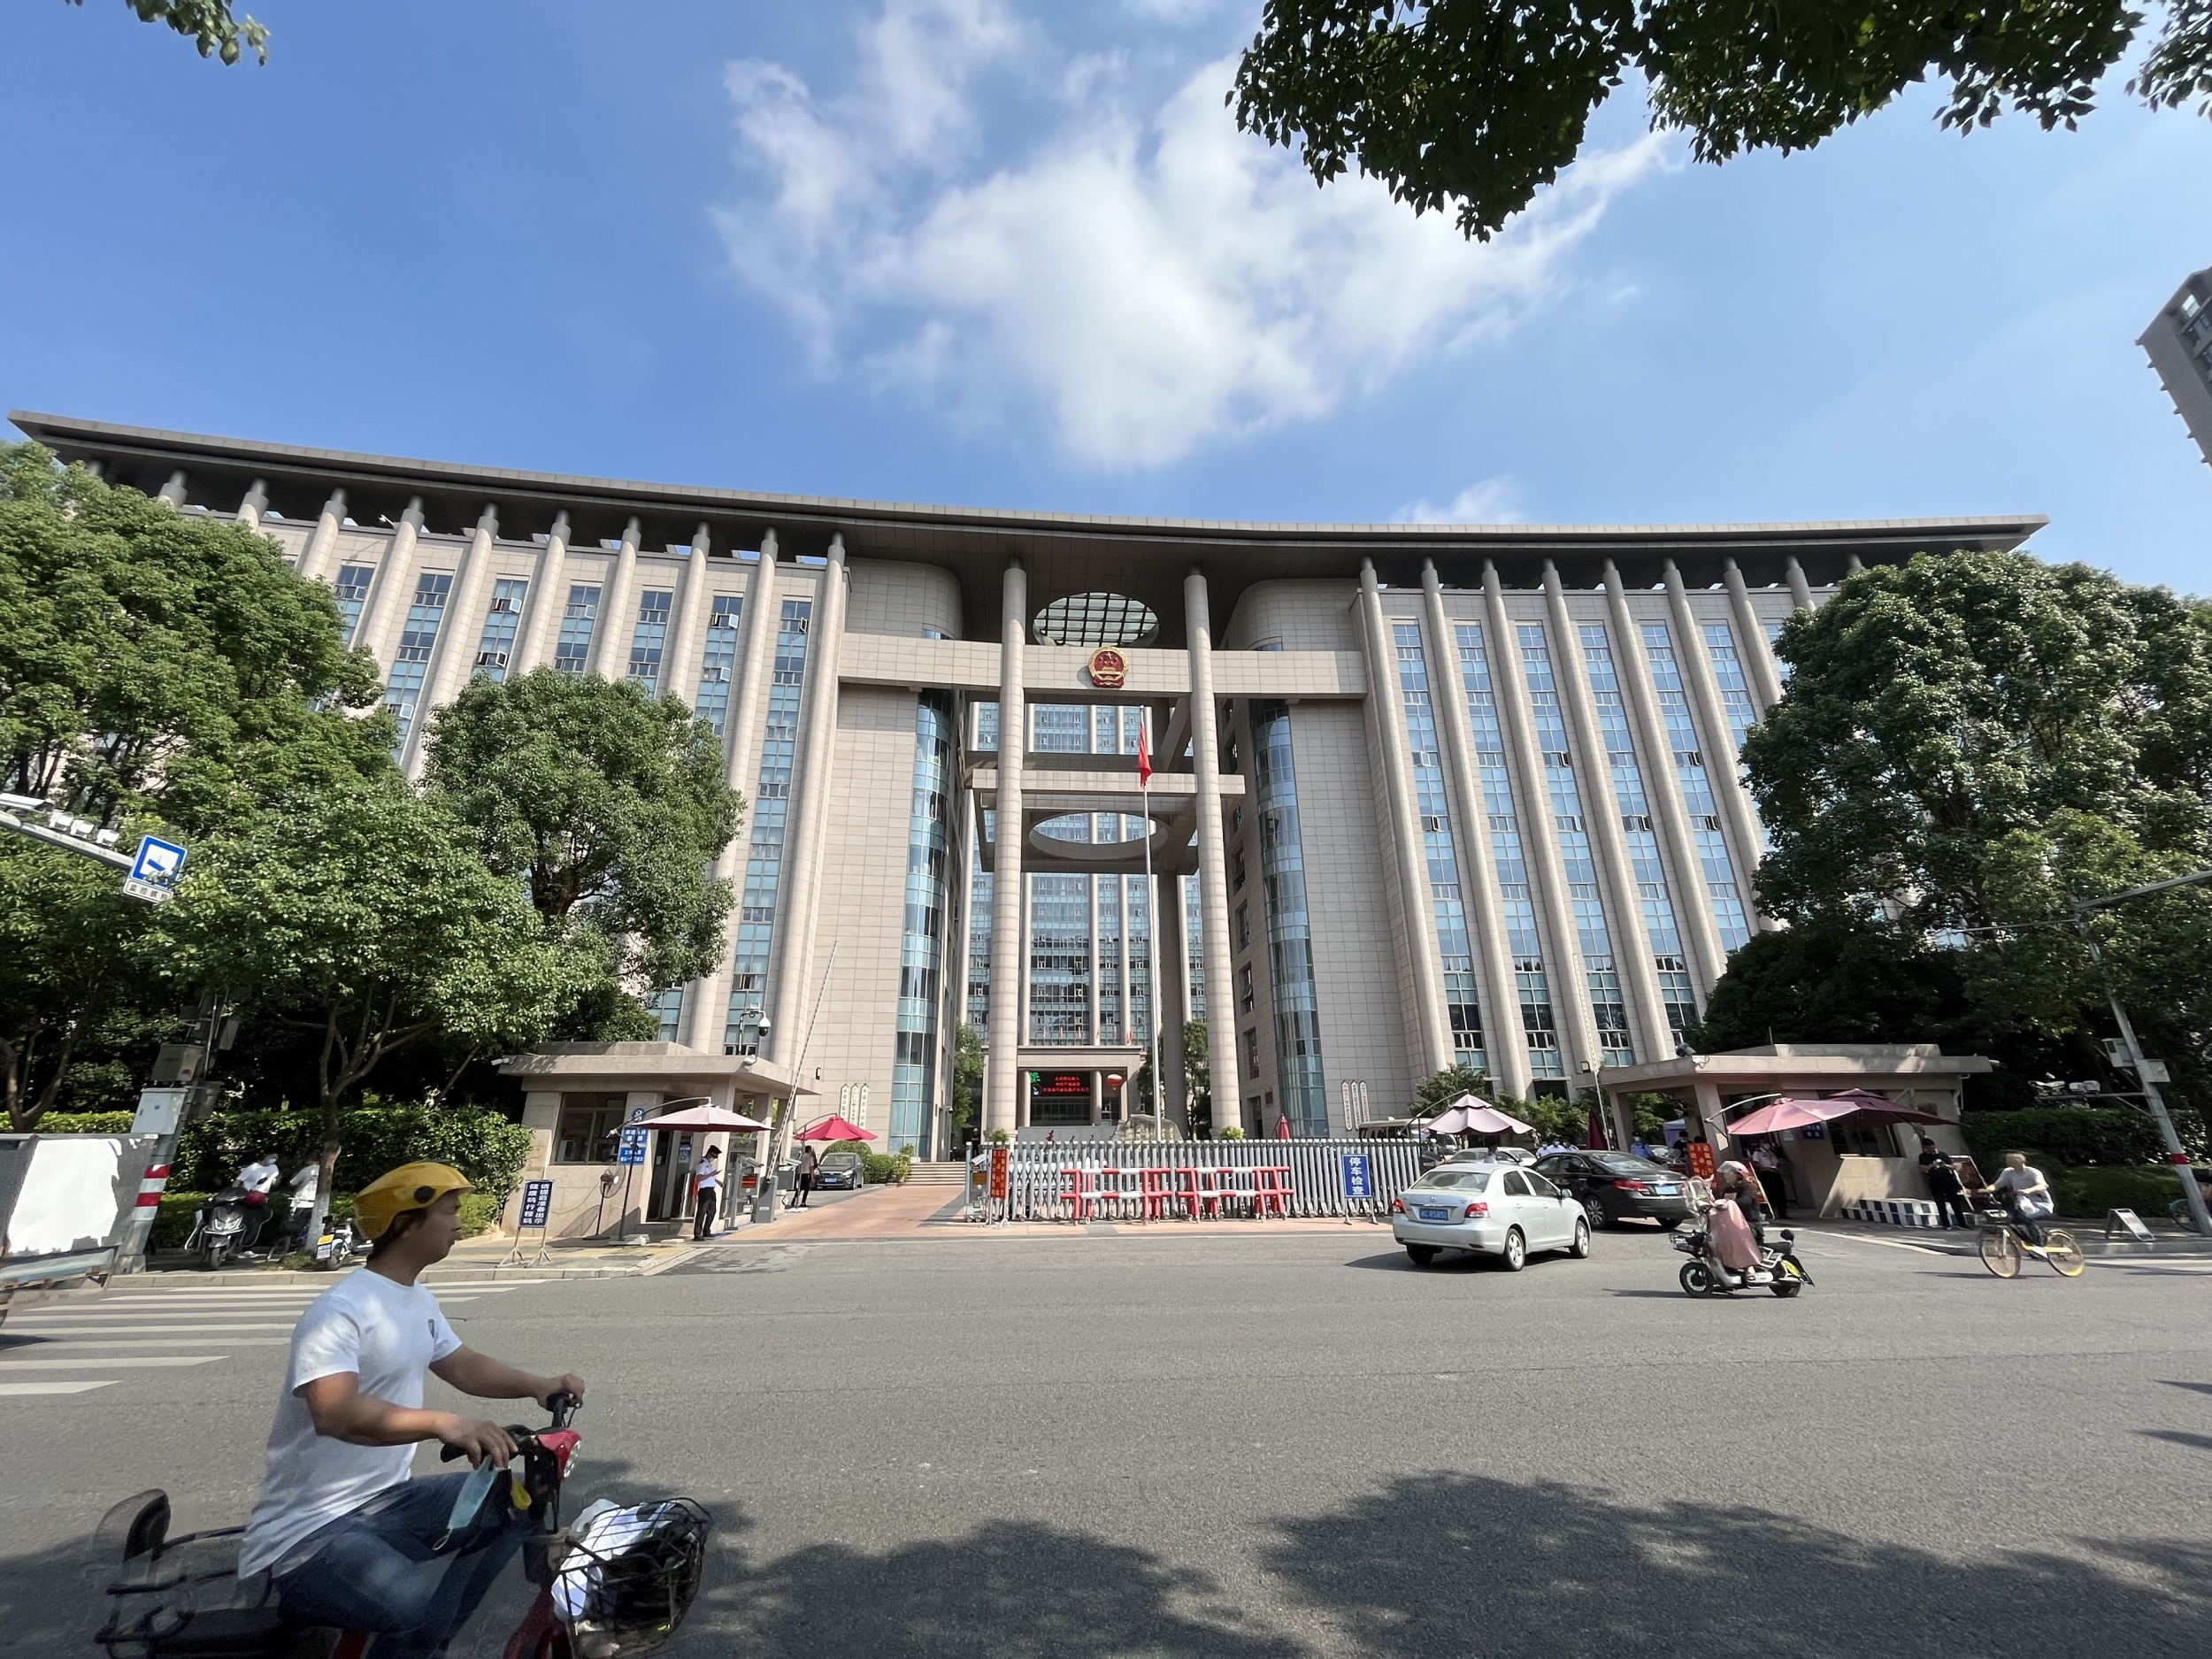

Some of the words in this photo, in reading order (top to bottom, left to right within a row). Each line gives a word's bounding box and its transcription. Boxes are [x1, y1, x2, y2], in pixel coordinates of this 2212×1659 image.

[1349, 1156, 1363, 1195] 停车检查
[523, 1183, 539, 1225] 健康码行程码
